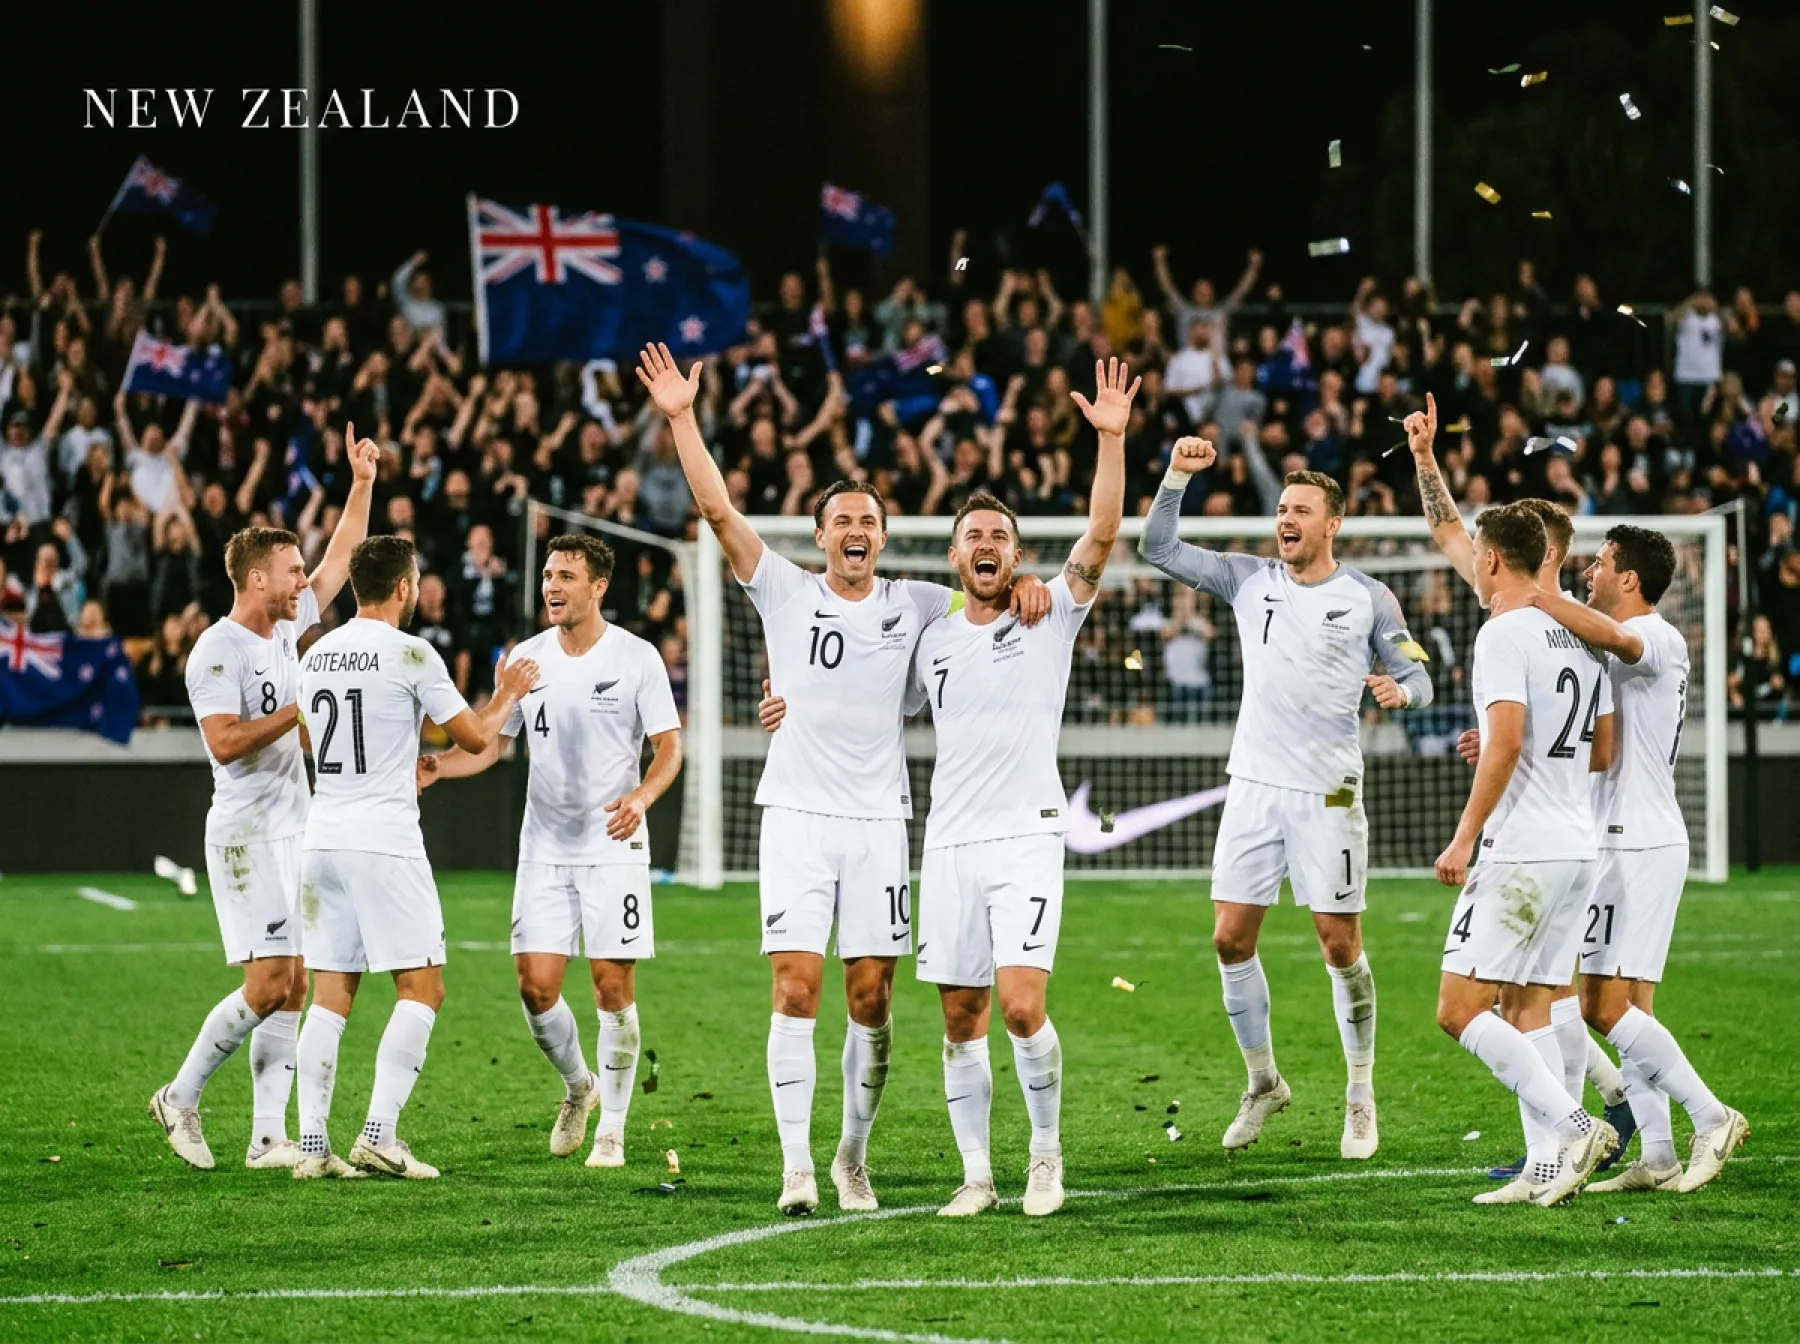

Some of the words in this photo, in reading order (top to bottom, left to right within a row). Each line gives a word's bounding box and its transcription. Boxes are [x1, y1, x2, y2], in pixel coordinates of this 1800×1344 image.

[1263, 608, 1274, 645] 1
[305, 652, 380, 673] AOTEAROA
[809, 625, 844, 670] 10
[260, 681, 277, 715] 8
[934, 668, 949, 709] 7
[311, 688, 367, 775] 21
[534, 700, 550, 738] 4
[1342, 848, 1352, 886] 1
[623, 893, 640, 930] 8
[885, 884, 910, 925] 10
[1029, 896, 1048, 937] 7
[1452, 902, 1475, 943] 4
[1583, 903, 1615, 945] 21
